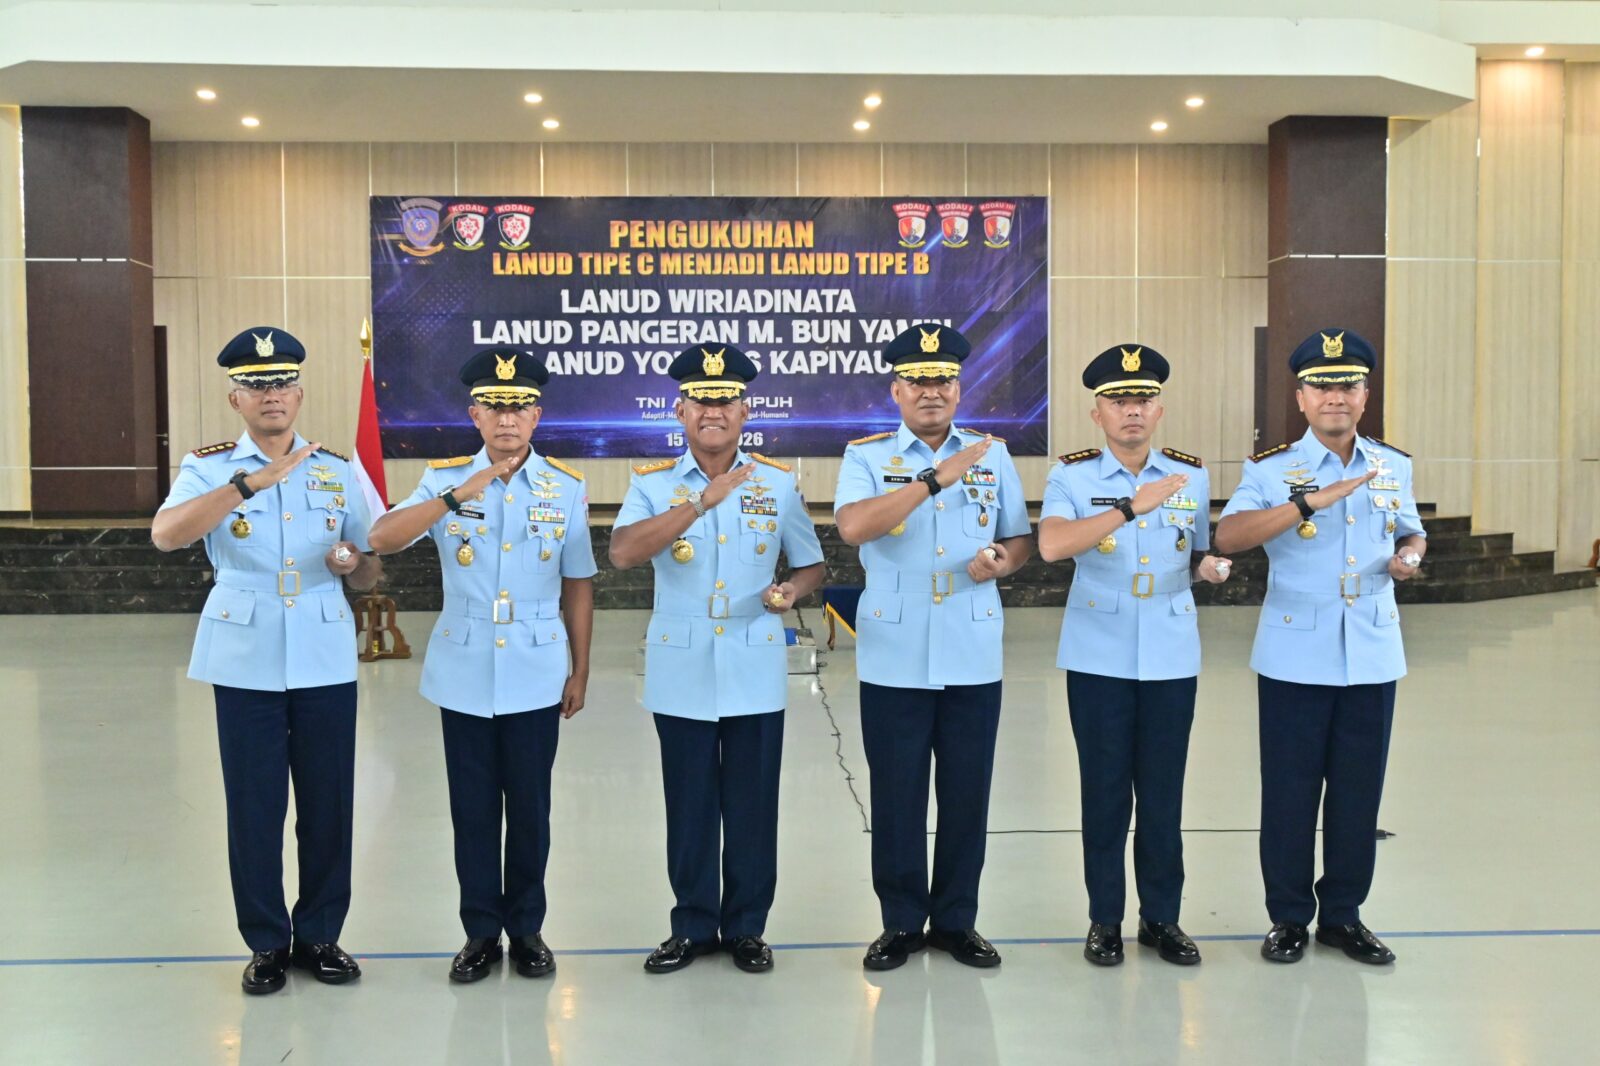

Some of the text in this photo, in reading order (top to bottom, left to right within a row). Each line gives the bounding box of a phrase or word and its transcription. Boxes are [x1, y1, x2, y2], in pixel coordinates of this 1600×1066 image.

[451, 203, 484, 212] KODAU
[498, 203, 531, 212] KODAU
[896, 203, 925, 211] KODAU
[939, 203, 968, 211] KODAU
[609, 220, 814, 248] PENGUKUHAN
[492, 251, 930, 276] LANUD TIPE C MENJADI LANUD TIPE B
[560, 288, 857, 314] LANUD WIRIADINATA
[472, 320, 573, 345] LANUD
[580, 319, 739, 344] PANGERAN
[747, 319, 783, 344] M.
[791, 319, 851, 344] BUN
[526, 351, 625, 376] ANUD
[769, 350, 894, 375] KAPIYAU
[635, 396, 666, 409] TNI
[742, 396, 793, 408] PUH
[665, 431, 764, 447] 15 26
